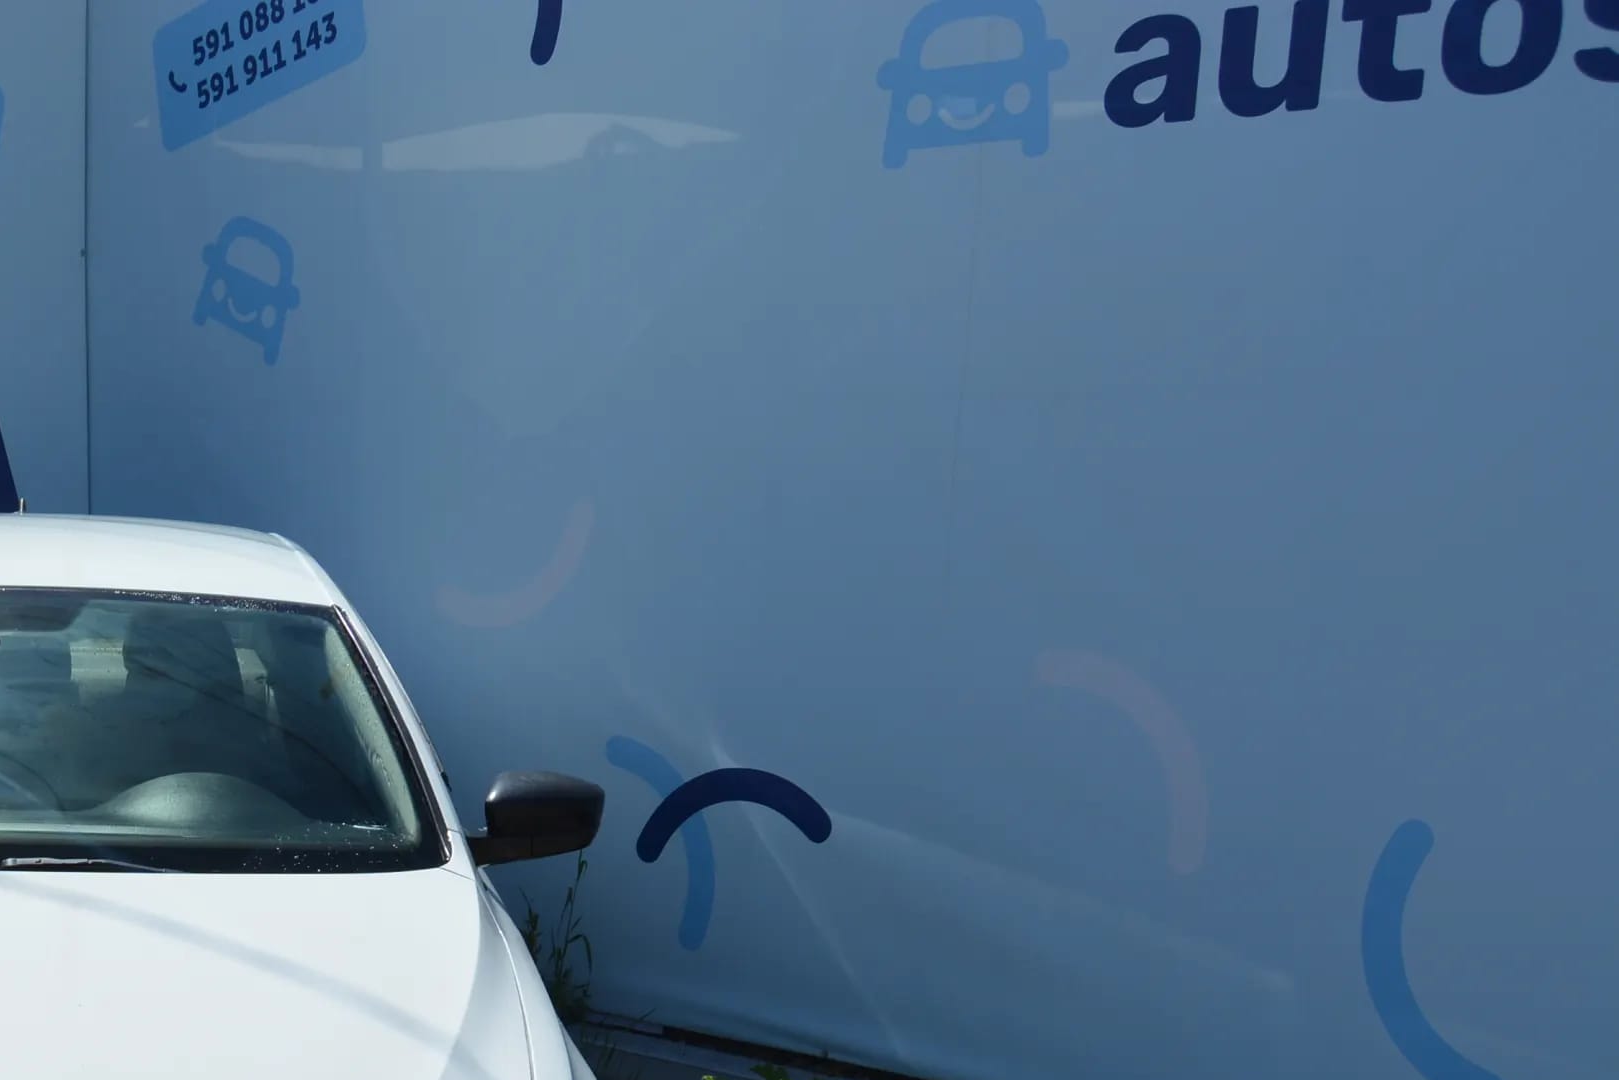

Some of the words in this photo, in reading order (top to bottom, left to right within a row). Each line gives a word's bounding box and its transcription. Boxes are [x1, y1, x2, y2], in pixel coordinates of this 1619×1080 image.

[192, 21, 235, 66] 591
[239, 0, 285, 40] 088
[196, 65, 239, 109] 591
[243, 40, 287, 85] 911
[291, 11, 338, 61] 143
